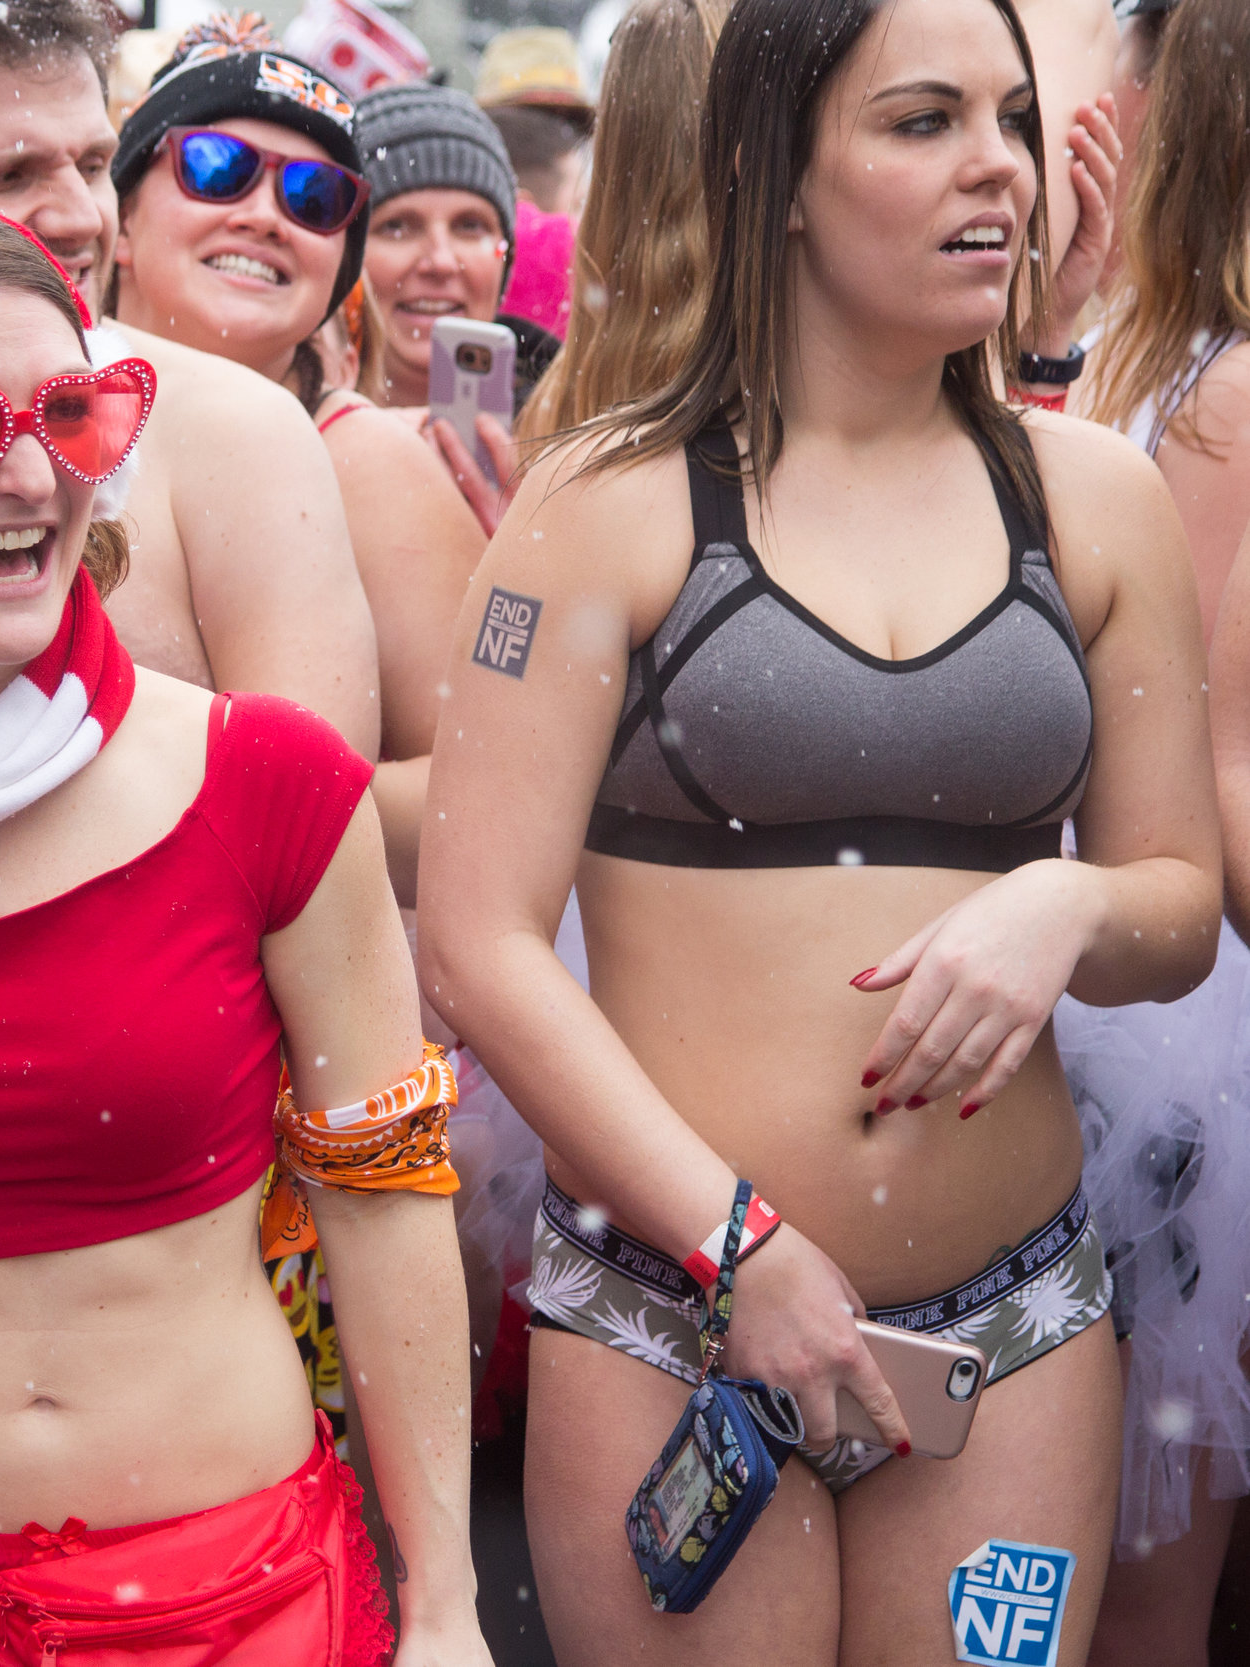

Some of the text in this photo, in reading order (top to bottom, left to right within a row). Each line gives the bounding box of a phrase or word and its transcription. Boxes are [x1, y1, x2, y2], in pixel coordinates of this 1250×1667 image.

[489, 594, 532, 628] END
[477, 625, 527, 668] NF
[617, 1243, 685, 1290] PINK
[956, 1264, 1014, 1311] PINK
[1020, 1220, 1070, 1272] PINK
[965, 1551, 1057, 1594] END
[956, 1595, 1052, 1659] NF
